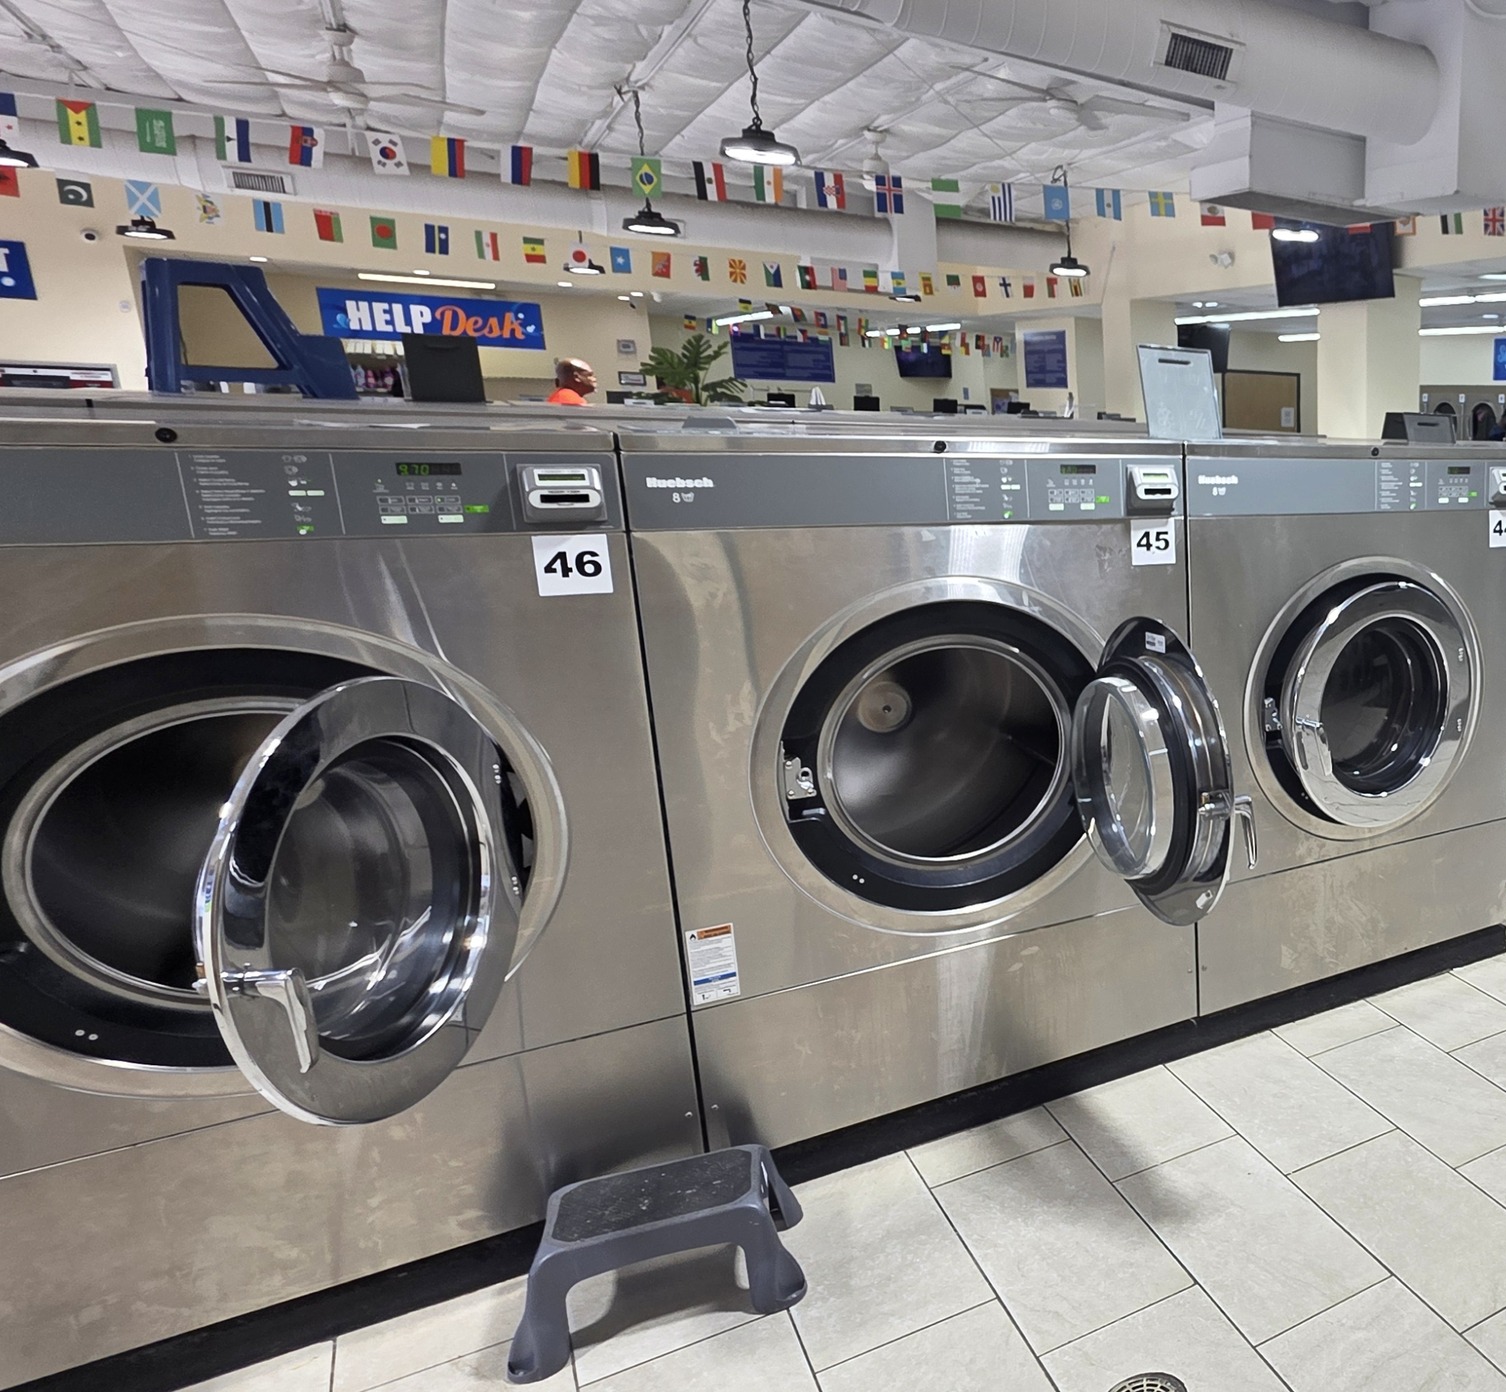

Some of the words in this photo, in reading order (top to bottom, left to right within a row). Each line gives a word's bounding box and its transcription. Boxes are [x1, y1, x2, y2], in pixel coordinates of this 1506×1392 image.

[345, 300, 432, 334] HELP
[435, 305, 526, 340] Desk
[646, 477, 714, 488] Huebsch
[1136, 531, 1170, 551] 45
[544, 550, 603, 578] 46
